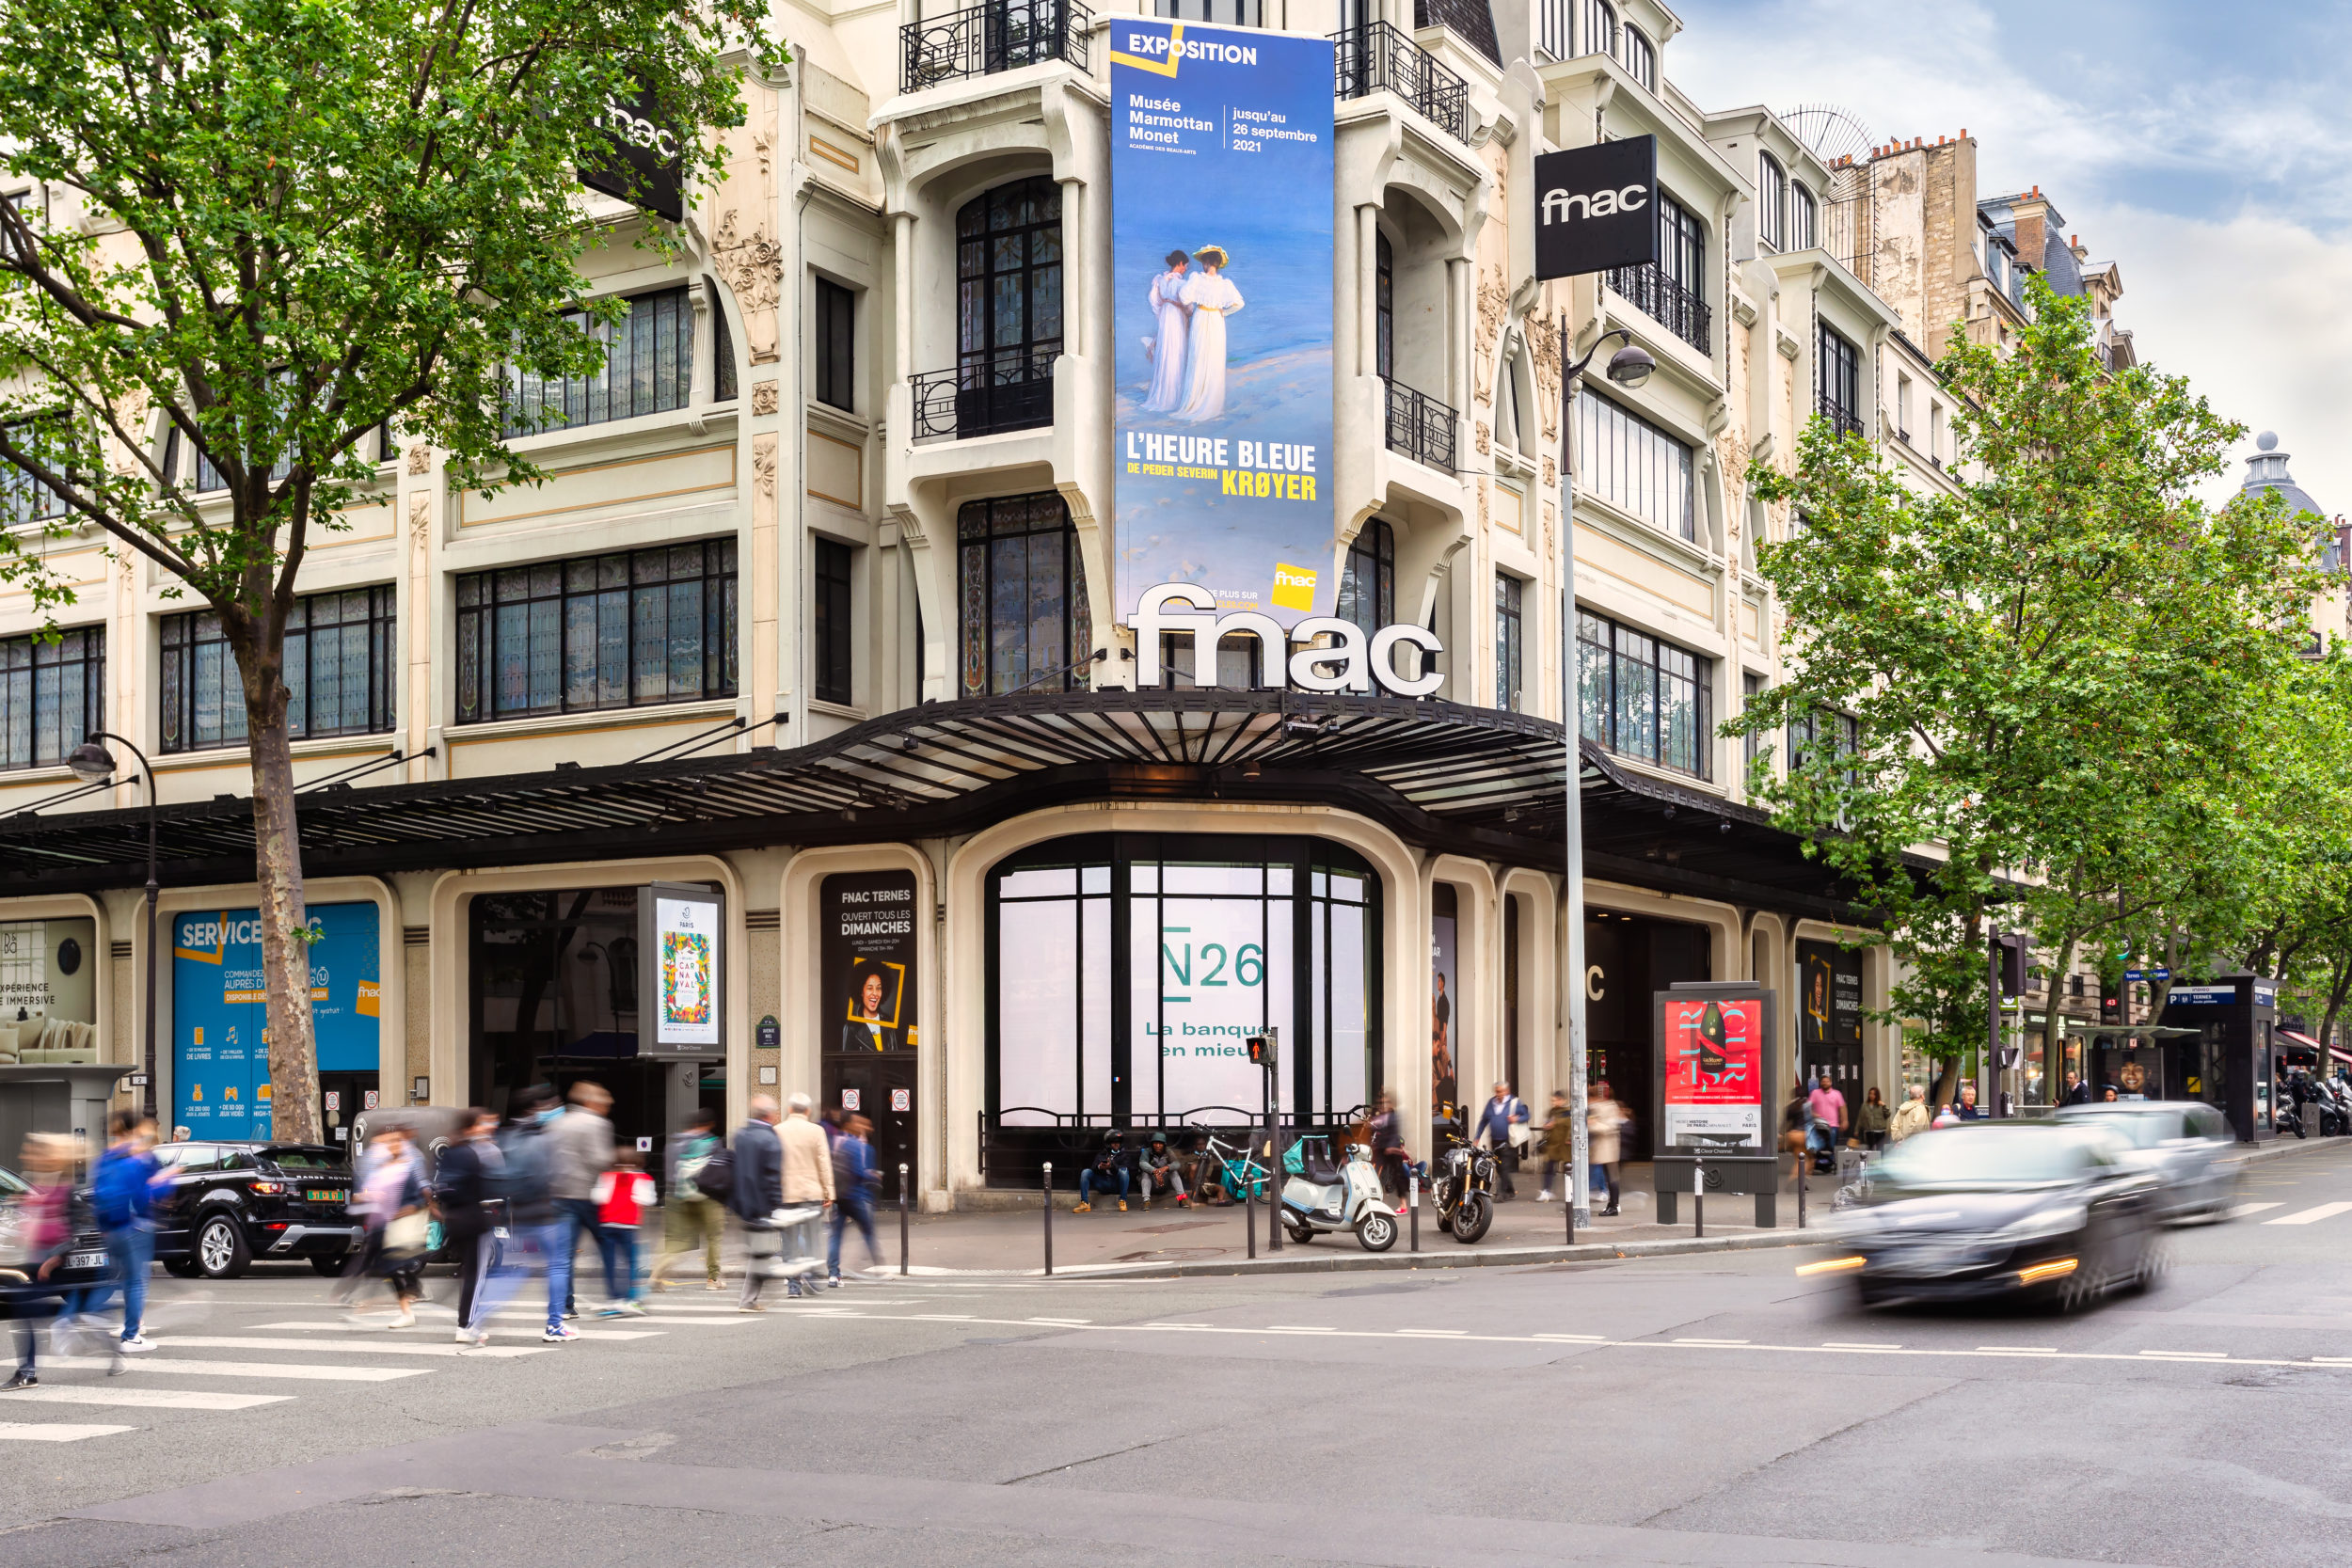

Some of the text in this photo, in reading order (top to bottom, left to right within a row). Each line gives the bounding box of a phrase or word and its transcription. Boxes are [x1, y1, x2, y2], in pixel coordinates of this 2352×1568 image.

[1129, 33, 1257, 66] EXPOSITION
[1130, 94, 1181, 112] Musée
[1130, 110, 1214, 132] Marmottan
[1232, 107, 1286, 123] jusqu'au
[1130, 126, 1179, 144] Monet
[1233, 123, 1318, 142] 26 septembre
[1129, 143, 1154, 151] ACADÉMIE
[1167, 147, 1197, 155] BEAUX-ARTS
[1233, 140, 1262, 152] 2021
[1541, 184, 1647, 226] fnac
[1127, 432, 1316, 472] L'HEURE BLEUE
[1127, 462, 1316, 500] DE PEDER SEVERIN KRØYER
[1275, 571, 1316, 588] fnac
[1219, 590, 1240, 598] PLUS
[1242, 591, 1258, 600] SUR
[1127, 581, 1446, 698] fnac
[841, 890, 911, 903] FNAC TERNES
[841, 910, 911, 922] OUVERT TOUS LES
[841, 920, 911, 936] DIMANCHES
[679, 961, 694, 970] CAR
[1163, 943, 1263, 987] N26
[224, 977, 254, 990] AUPRÈS
[679, 980, 695, 989] VAL
[1836, 974, 1859, 986] FNAC TERNES
[0, 982, 49, 993] XPÉRIENCE
[7, 995, 56, 1006] IMMERSIVE
[226, 990, 256, 1001] DISPONIBLE
[2169, 995, 2177, 1005] P
[1836, 999, 1859, 1011] DIMANCHES
[1146, 1022, 1271, 1039] La banque
[1162, 1043, 1250, 1057] en mieu
